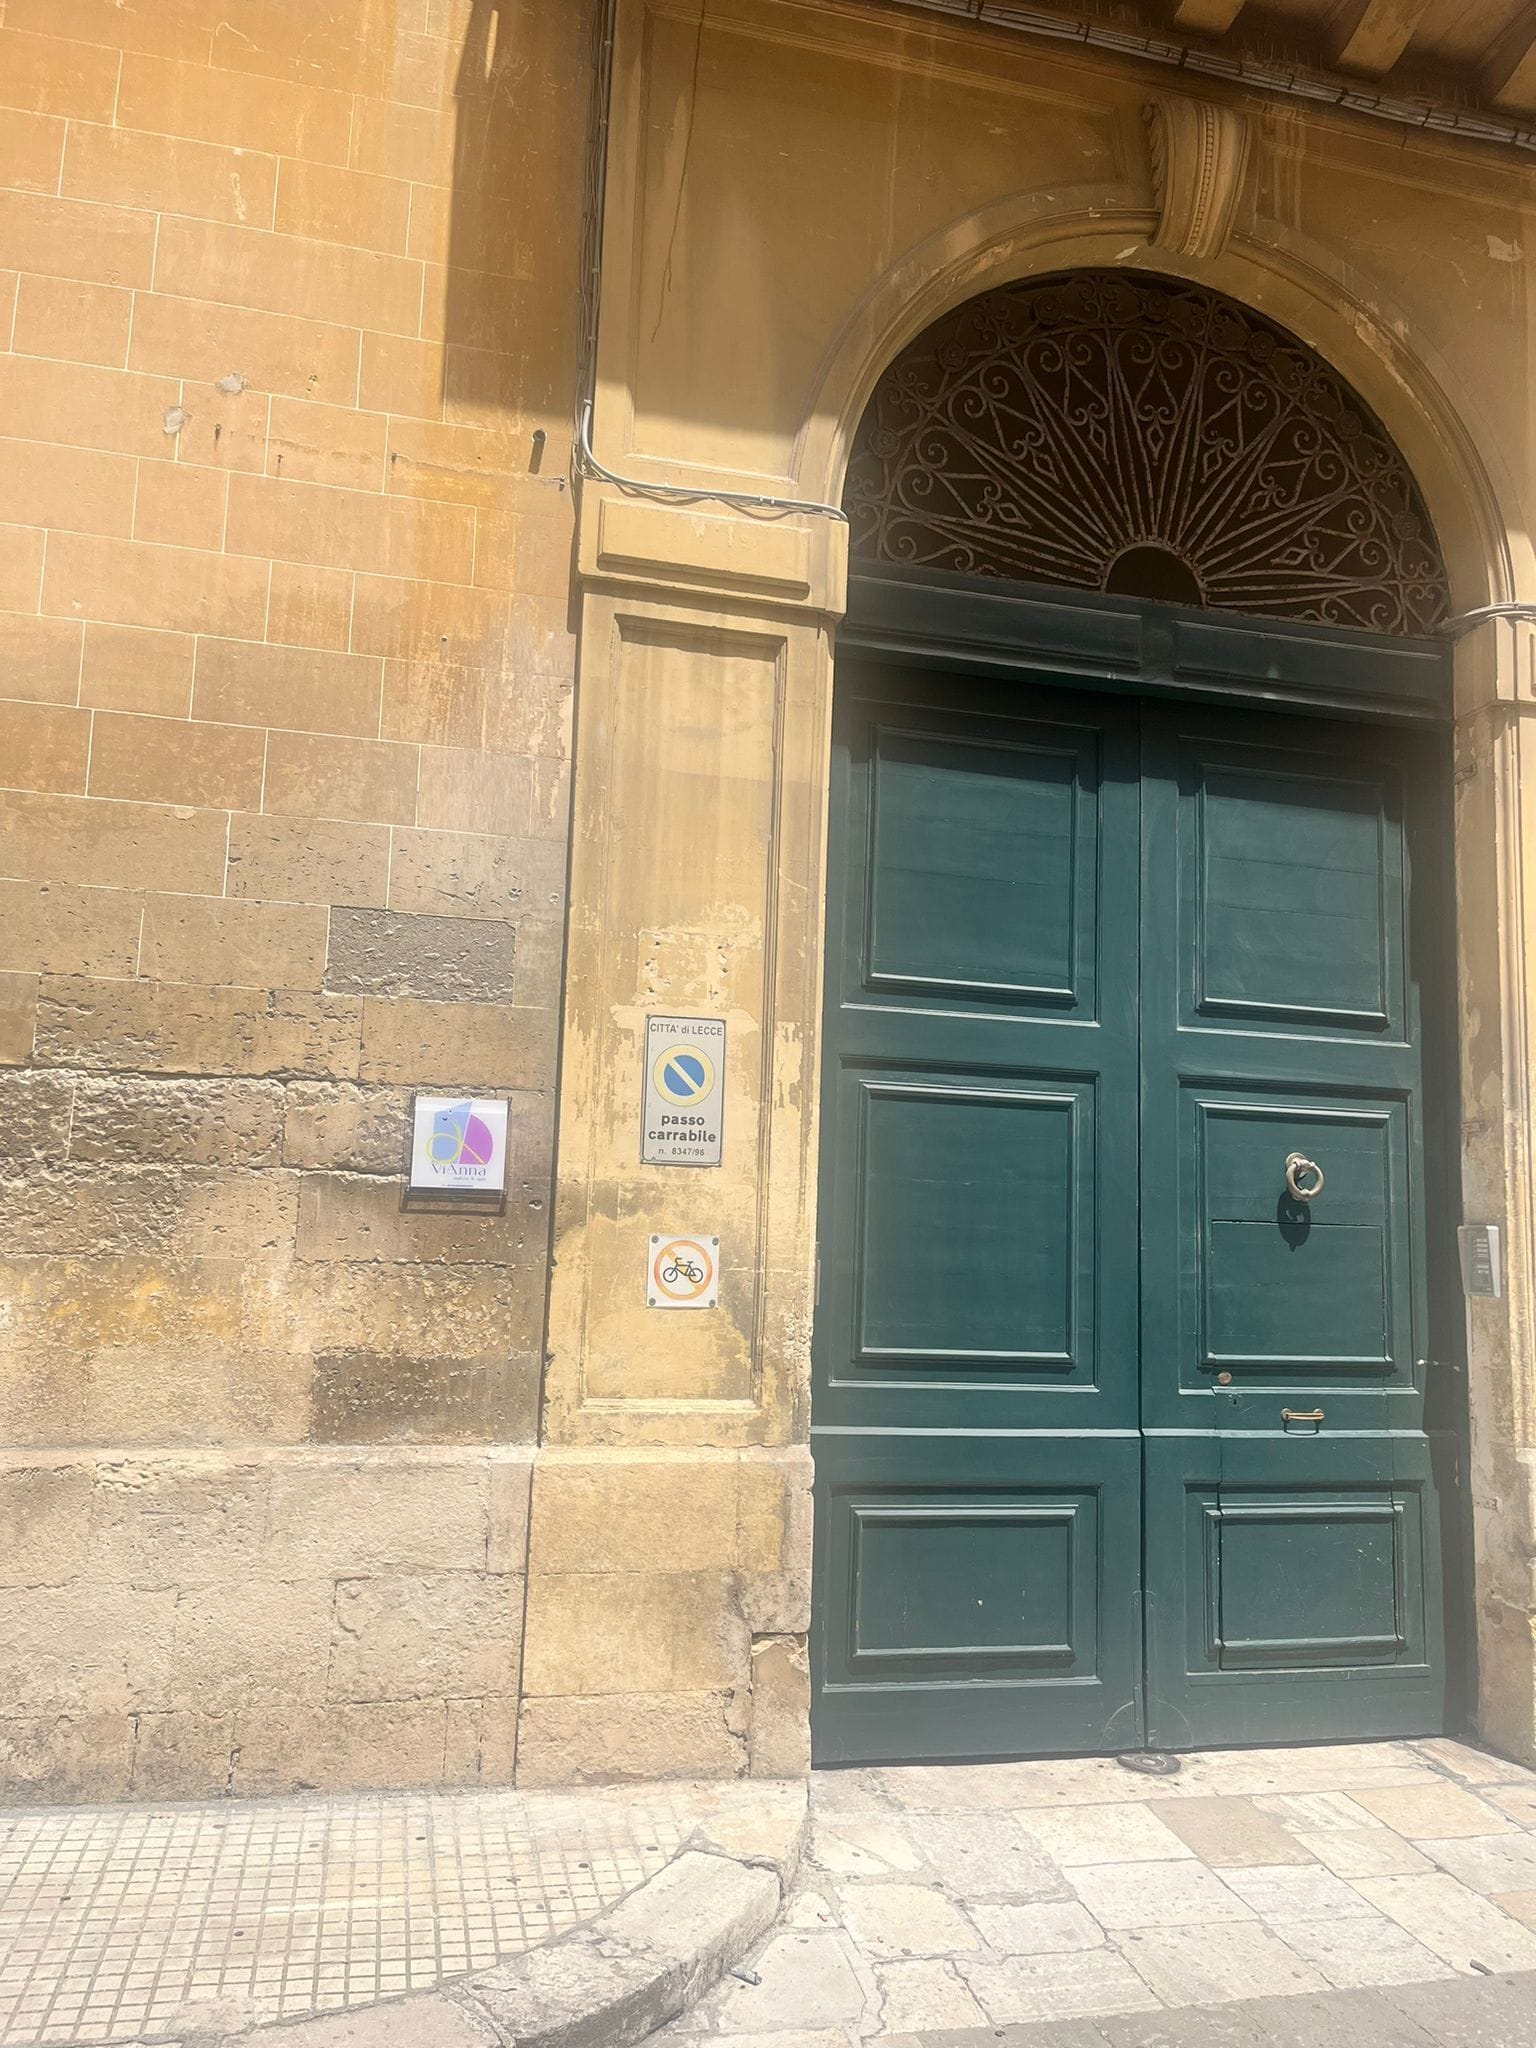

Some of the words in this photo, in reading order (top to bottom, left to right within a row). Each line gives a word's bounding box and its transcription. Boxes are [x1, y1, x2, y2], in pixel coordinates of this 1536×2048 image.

[681, 1025, 689, 1034] di
[692, 1025, 722, 1036] LECCE
[661, 1115, 705, 1126] passo
[648, 1129, 716, 1142] carrabile
[672, 1147, 705, 1156] 8347/96
